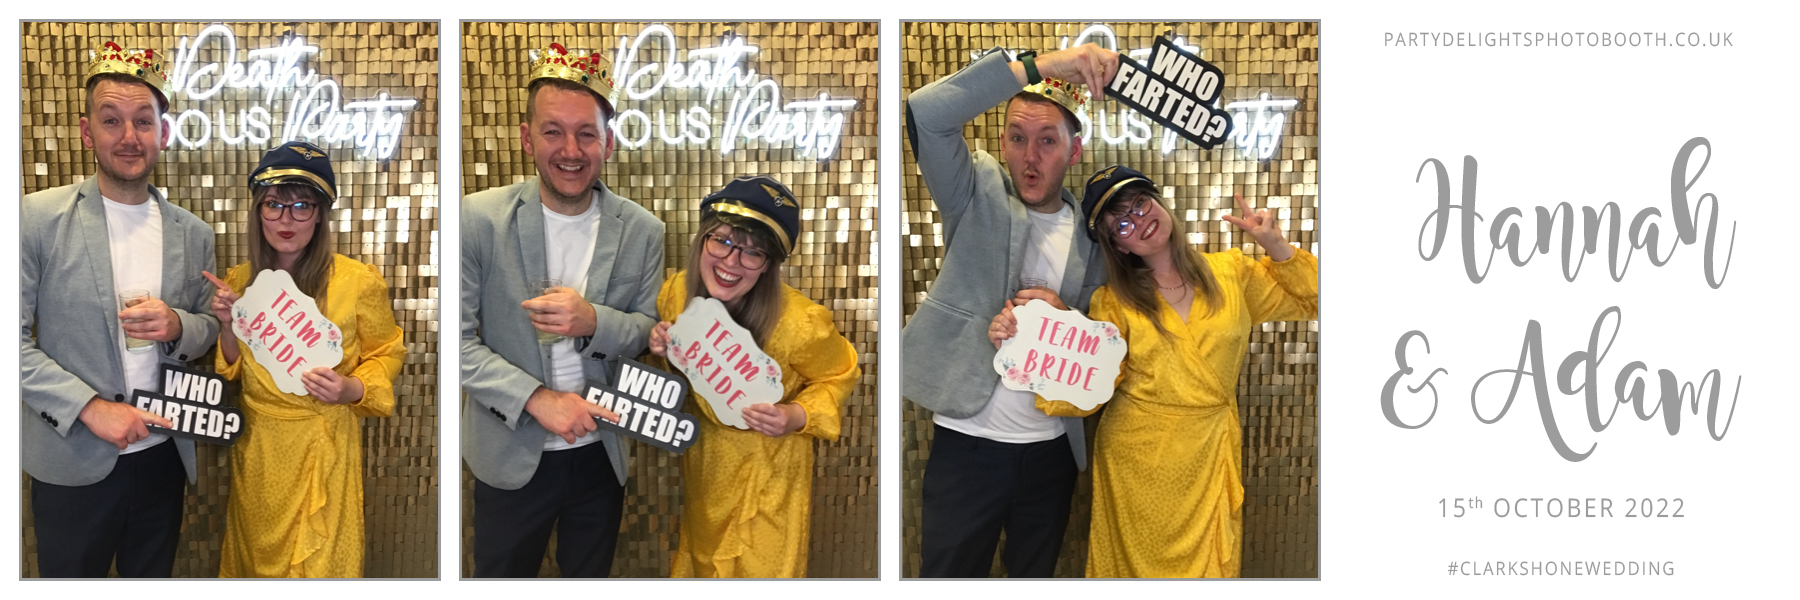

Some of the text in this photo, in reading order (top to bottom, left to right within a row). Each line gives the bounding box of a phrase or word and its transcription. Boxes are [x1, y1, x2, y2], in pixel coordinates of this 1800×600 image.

[172, 24, 318, 105] Death
[613, 24, 758, 105] Death
[1151, 43, 1220, 101] WHO
[218, 106, 272, 145] US
[281, 79, 418, 160] Party
[658, 106, 712, 145] US
[721, 79, 858, 160] Party
[1110, 62, 1228, 143] FARTED?
[249, 311, 308, 378] BRIDE
[271, 288, 322, 348] TEAM
[705, 318, 760, 382] TEAM
[1038, 316, 1101, 356] TEAM
[164, 369, 223, 406] WHO
[617, 363, 682, 409] WHO
[684, 340, 747, 410] BRIDE
[1023, 348, 1099, 392] BRIDE
